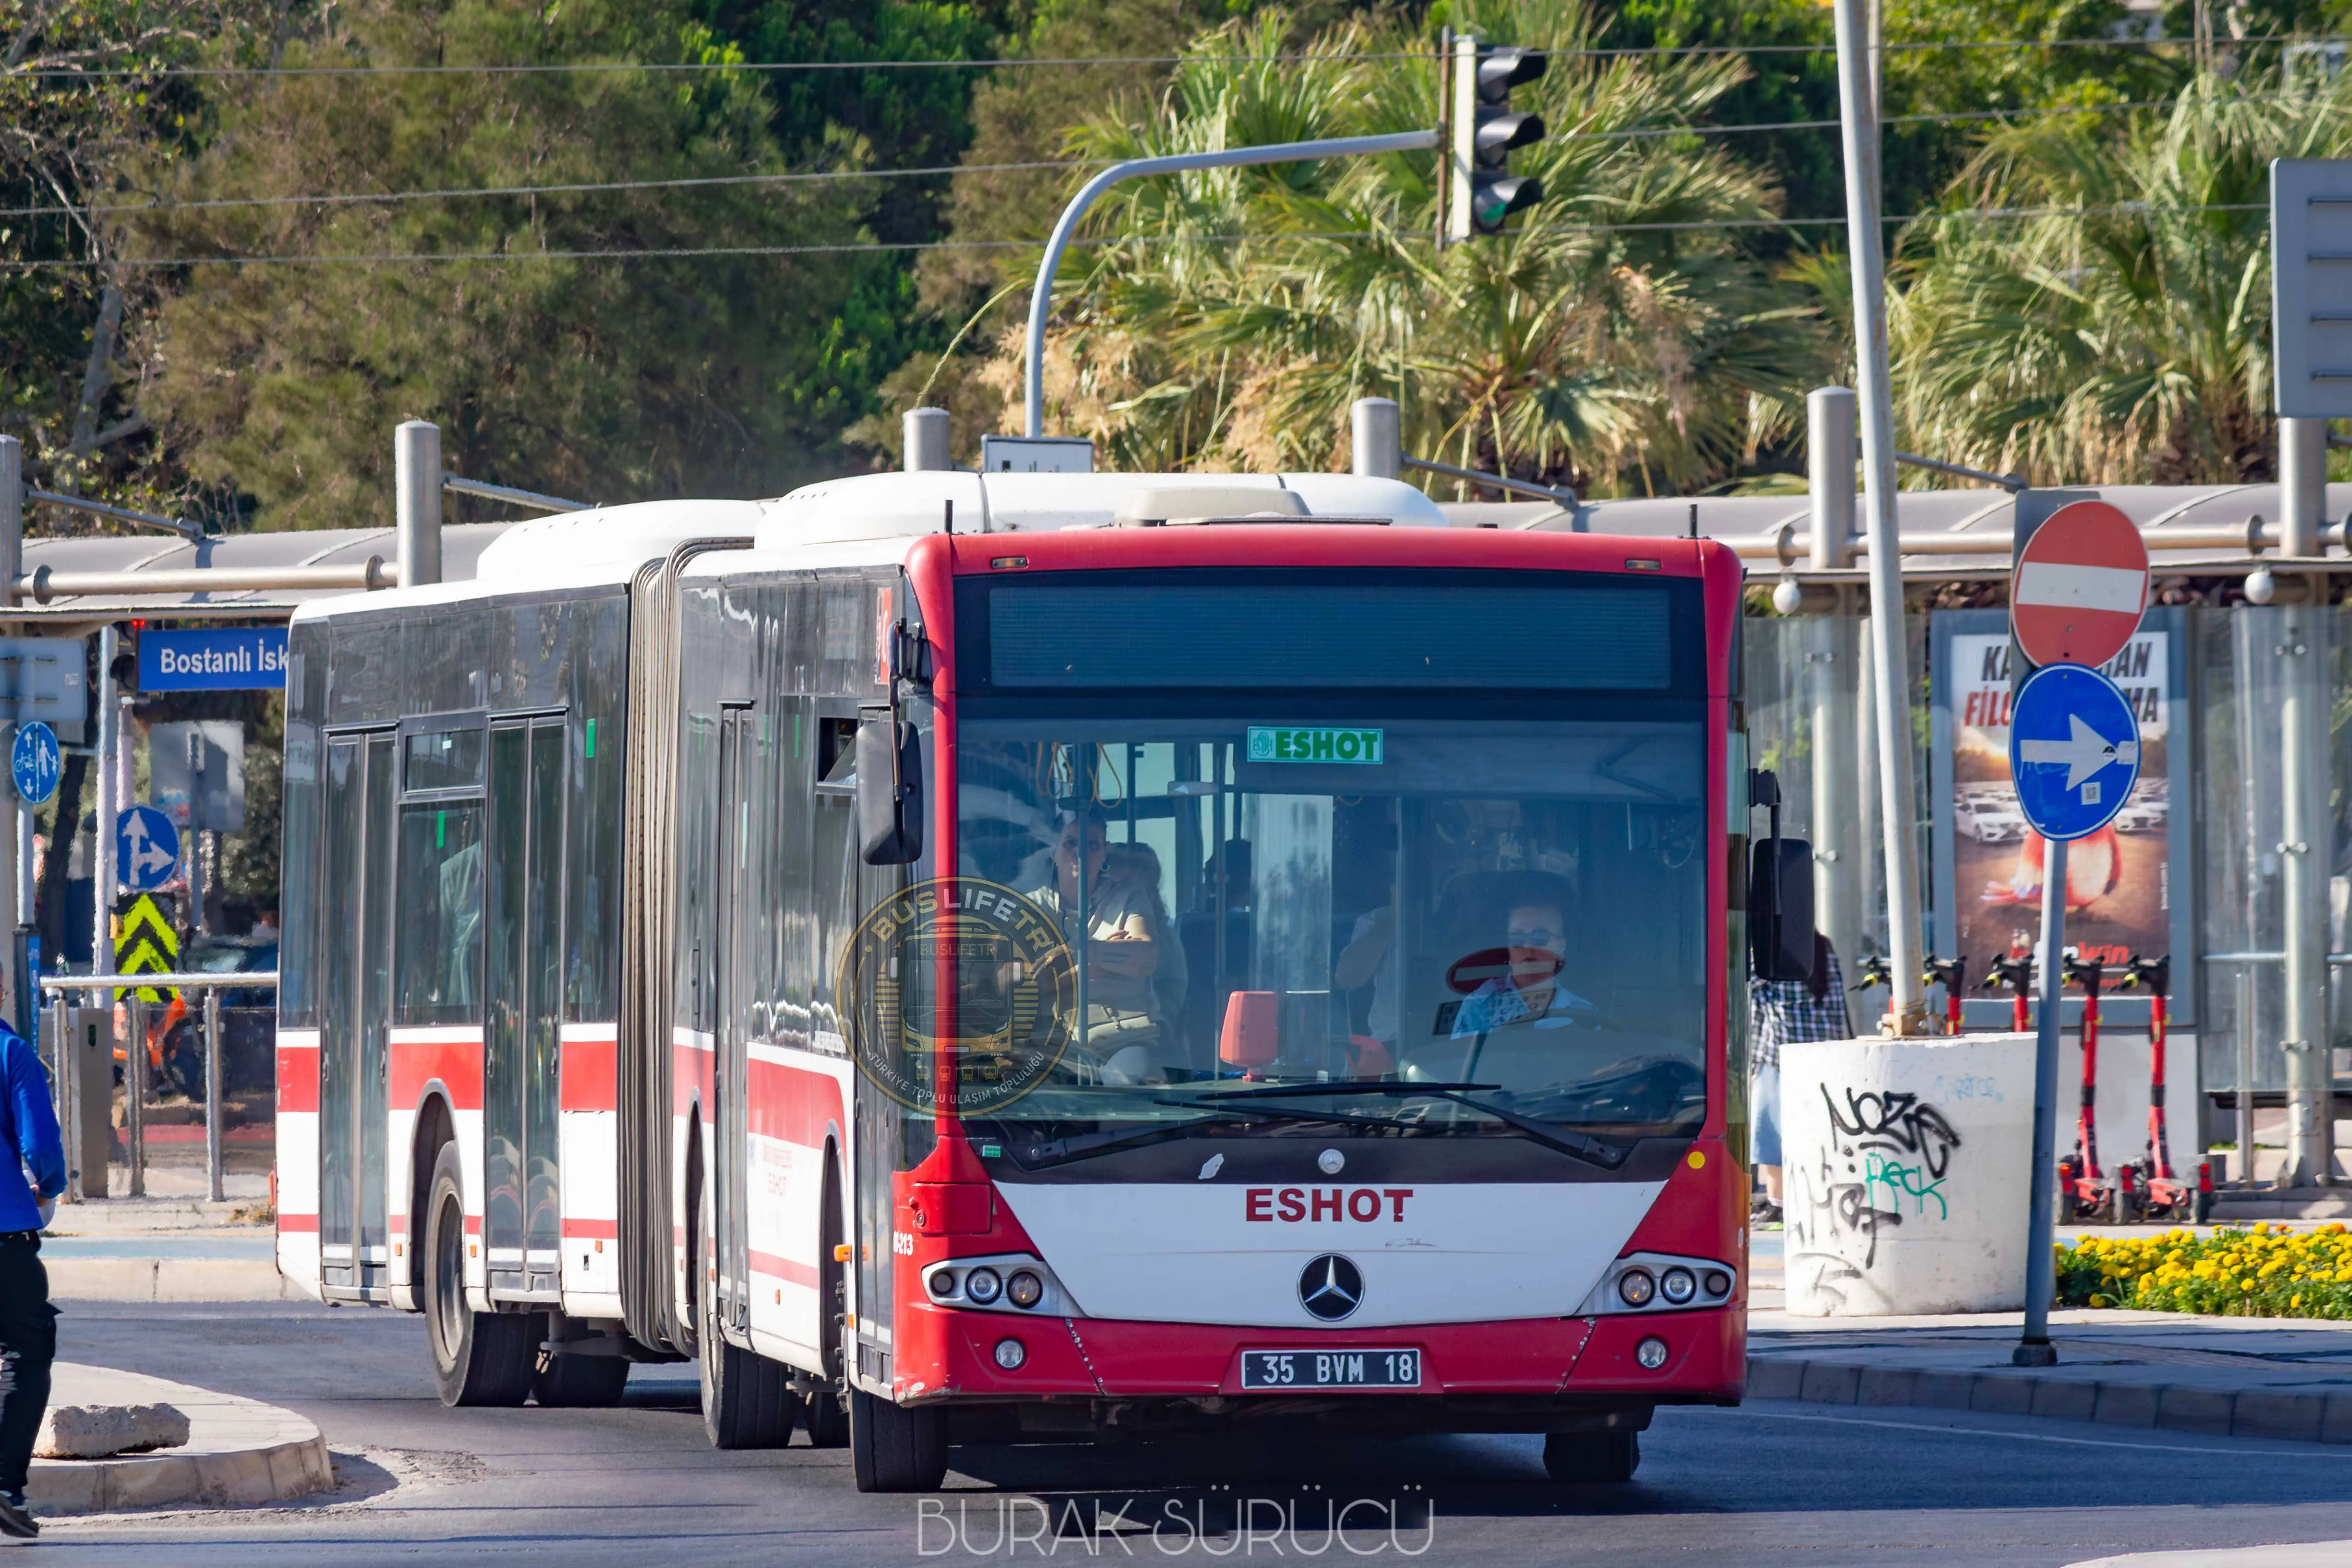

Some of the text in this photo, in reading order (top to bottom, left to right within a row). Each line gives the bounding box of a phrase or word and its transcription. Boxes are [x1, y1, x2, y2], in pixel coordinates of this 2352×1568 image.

[161, 645, 251, 674] Bostanlı
[1275, 731, 1378, 760] ESHOT
[1246, 1188, 1414, 1222] ESHOT
[1262, 1354, 1413, 1383] 35 BVM 18
